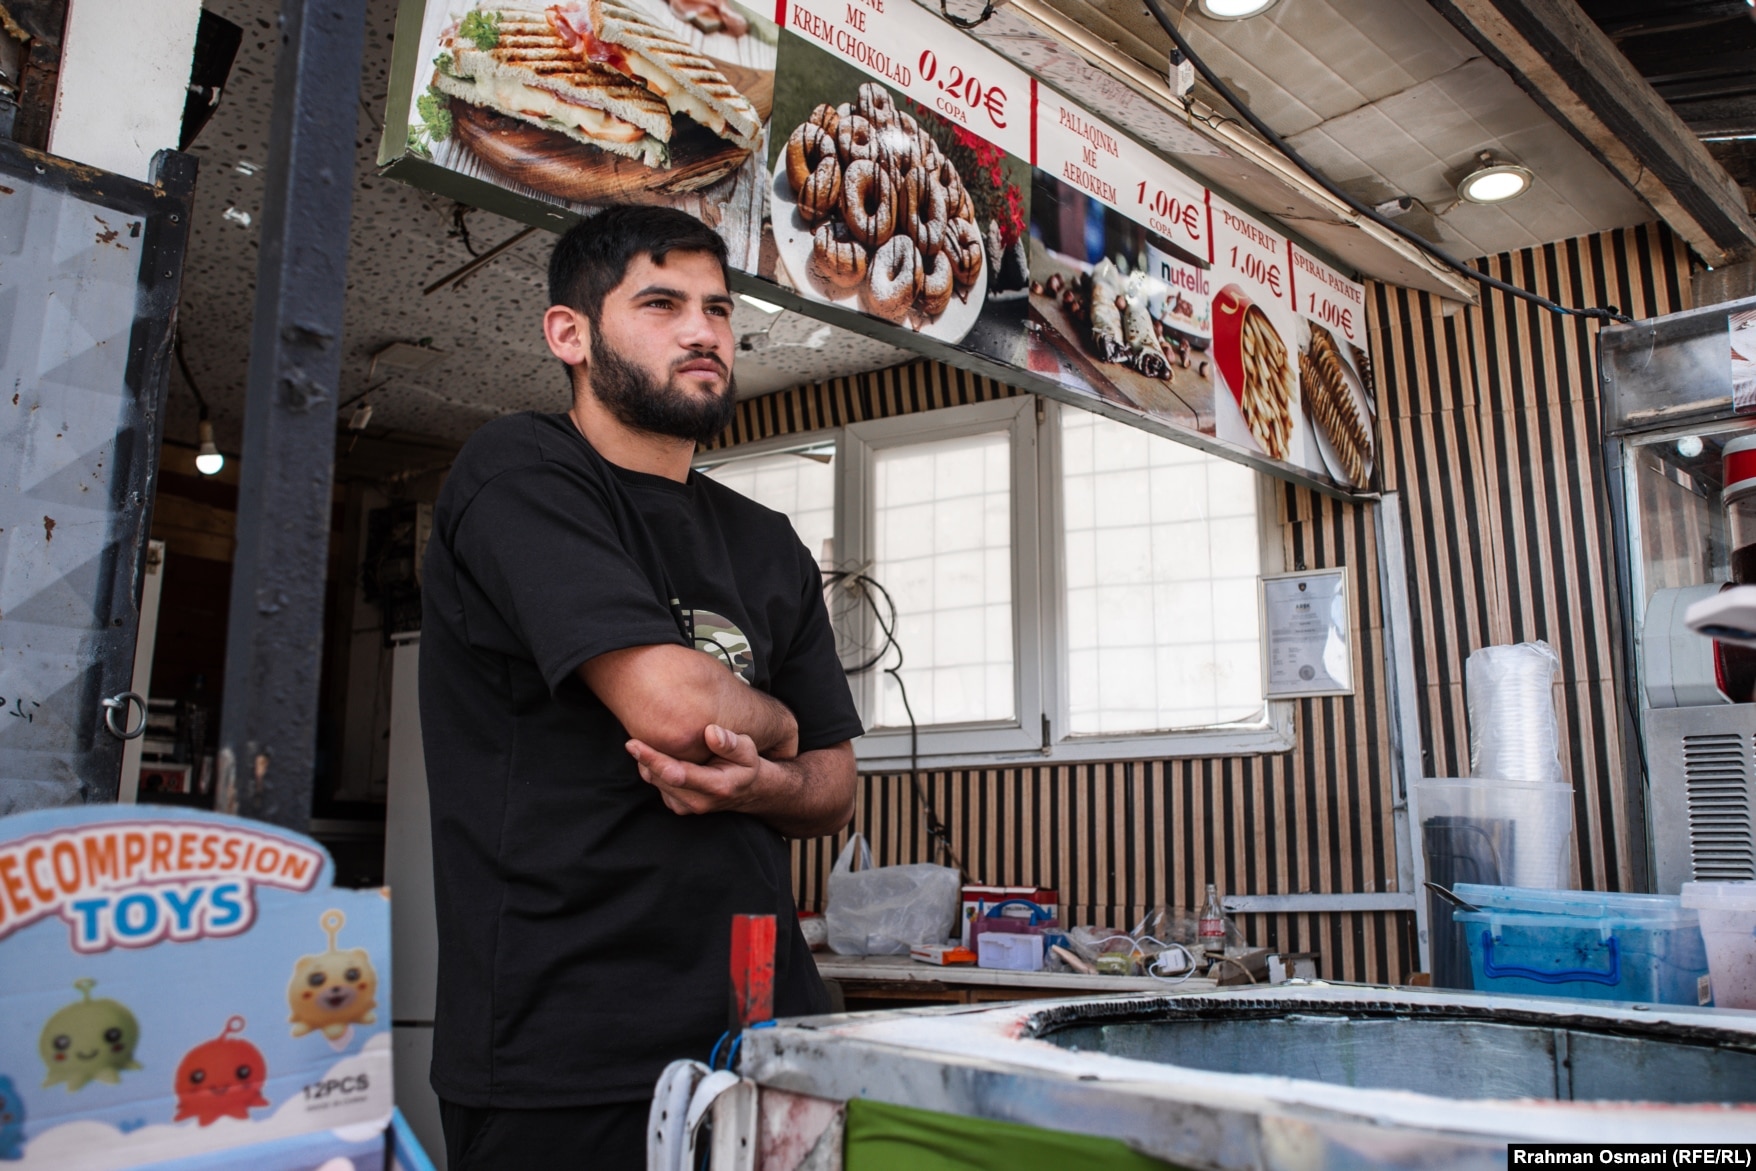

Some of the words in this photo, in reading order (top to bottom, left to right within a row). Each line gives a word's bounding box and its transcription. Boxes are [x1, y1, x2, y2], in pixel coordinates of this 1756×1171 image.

[845, 3, 867, 33] ME
[792, 3, 836, 47] KREM
[836, 29, 912, 88] CHOKOLAD
[917, 48, 1009, 130] 0.20€
[936, 97, 968, 124] COPA
[1059, 106, 1119, 159] PALLAQINKA
[1082, 145, 1098, 170] ME
[1062, 160, 1118, 206] AEROKREM
[1136, 180, 1201, 241] 1.00€
[1149, 217, 1173, 239] COPA
[1223, 210, 1277, 254] POMFRIT
[1161, 260, 1210, 297] nutella
[1230, 246, 1282, 298] 1.00€
[1293, 251, 1328, 284] SPIRAL
[1328, 272, 1362, 305] PATATE
[1309, 292, 1354, 340] 1.00€
[0, 832, 309, 925] ECOMPRESSION
[72, 882, 243, 942] TOYS
[302, 1072, 369, 1101] 12PCS
